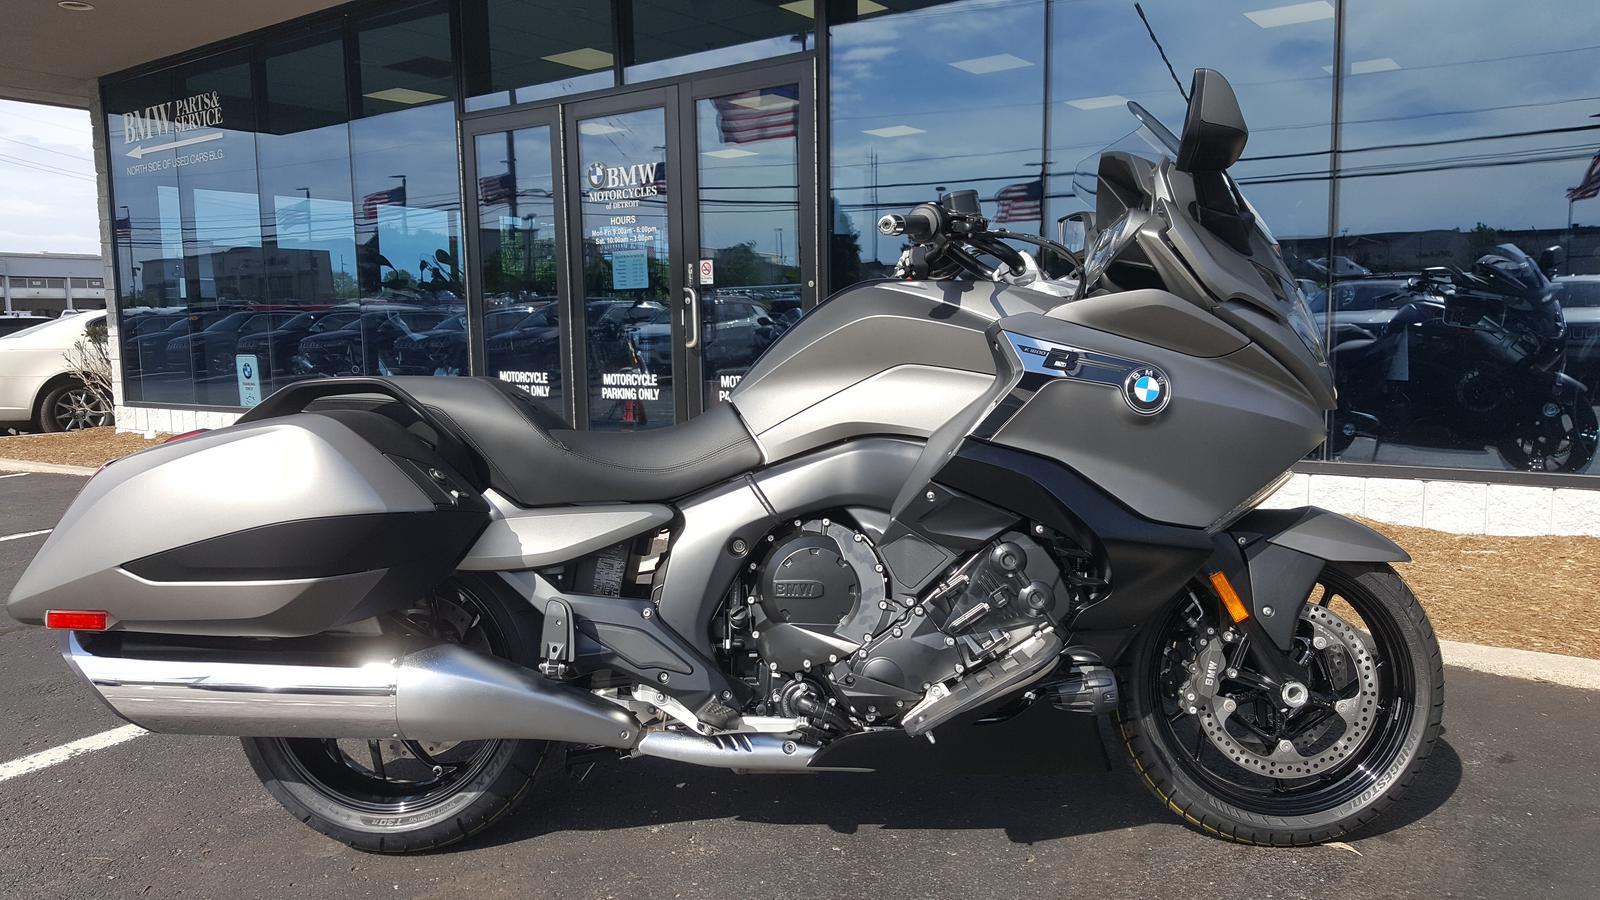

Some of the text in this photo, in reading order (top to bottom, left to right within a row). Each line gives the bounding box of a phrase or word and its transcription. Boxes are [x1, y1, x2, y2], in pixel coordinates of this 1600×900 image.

[122, 102, 172, 144] BMW
[174, 107, 223, 133] SERVICE
[126, 164, 148, 176] NORTH
[148, 160, 161, 172] SIDE
[162, 158, 172, 169] OF
[190, 151, 209, 164] CARS
[607, 163, 657, 188] BMW
[590, 186, 658, 202] MOTORCYCLES
[613, 201, 640, 209] DETROIT
[610, 215, 636, 225] HOURS
[499, 370, 549, 384] MOTORCYCLE
[602, 373, 658, 387] MOTORCYCLE
[530, 384, 550, 397] ONLY
[601, 387, 660, 401] PARKING ONLY
[775, 583, 815, 598] BMW
[1205, 660, 1218, 686] BMW
